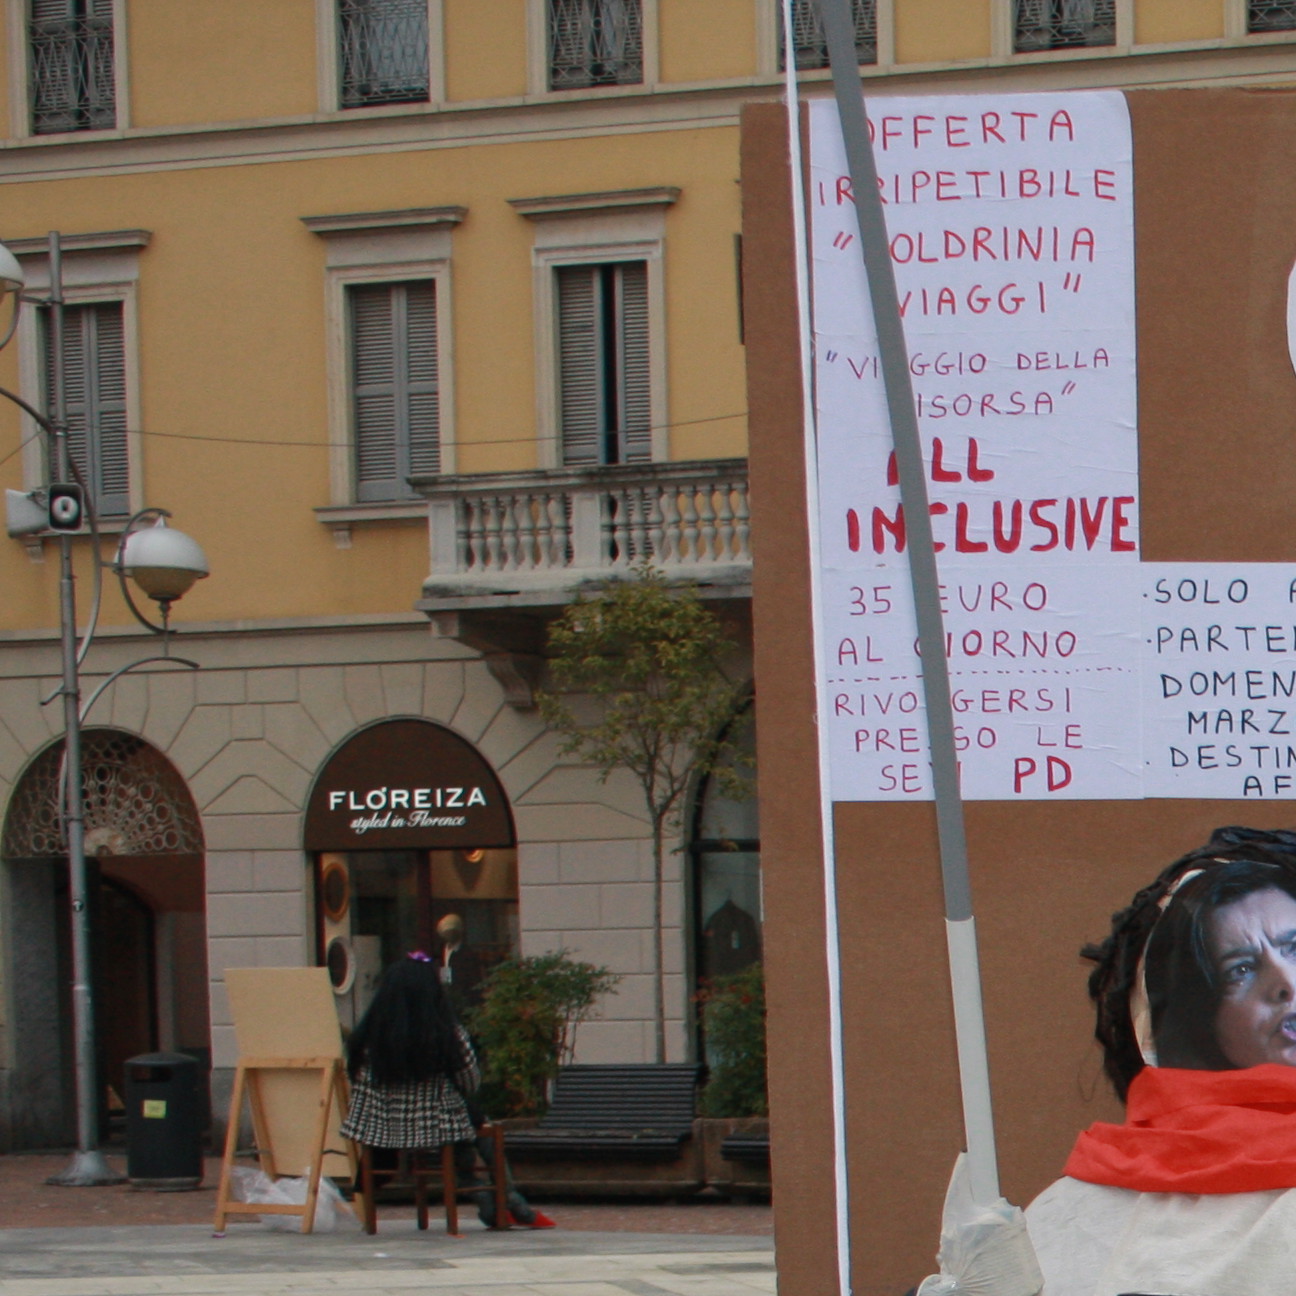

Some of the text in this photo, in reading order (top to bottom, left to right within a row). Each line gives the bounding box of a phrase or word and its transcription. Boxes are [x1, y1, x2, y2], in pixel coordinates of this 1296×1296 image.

[865, 109, 1075, 151] FFERTA
[832, 226, 1096, 266] "OLDRINIA
[825, 347, 1111, 380] "VIGGIO DELLA
[916, 380, 1077, 419] ISORSA"
[849, 584, 894, 617] 35
[836, 629, 1078, 667] AL IORNO
[833, 687, 1074, 718] RIVOGERSI
[854, 722, 1085, 755] PRESO LE
[878, 755, 1074, 794] SEI PD
[350, 811, 465, 834] styled in Florence
